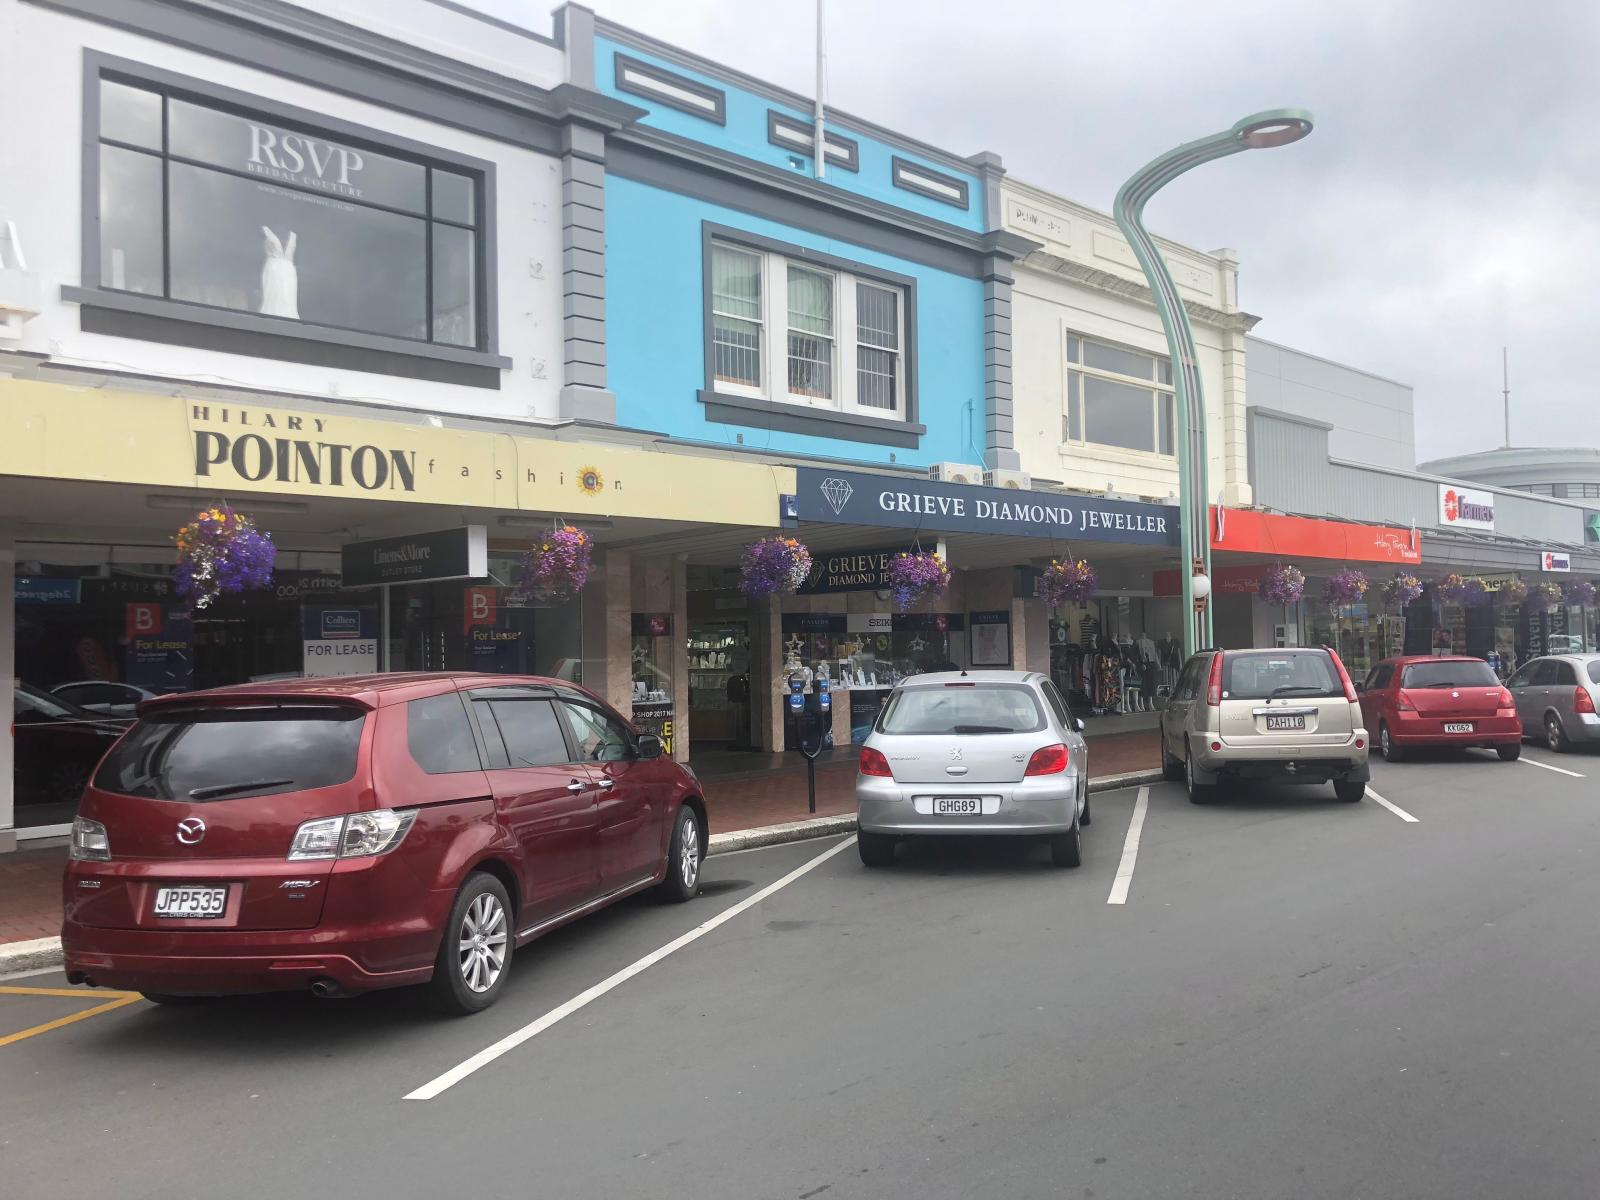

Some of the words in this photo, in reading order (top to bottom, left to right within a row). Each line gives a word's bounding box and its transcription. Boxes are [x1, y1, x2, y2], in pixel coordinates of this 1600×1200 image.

[248, 125, 363, 185] RSVP
[247, 162, 297, 181] BRIDAL
[303, 176, 362, 197] COUTURE
[192, 405, 327, 432] HILARY
[193, 430, 416, 491] POINTON
[428, 459, 623, 491] fashin
[879, 491, 965, 517] GRIEVE
[975, 500, 1073, 525] DIAMOND
[1080, 510, 1167, 533] JEWELLER
[1457, 495, 1494, 522] Farmers
[828, 554, 889, 574] GRIEVE
[829, 573, 875, 586] DIAMOND
[868, 618, 892, 627] SEIK
[473, 631, 488, 641] For
[307, 645, 332, 656] FOR
[335, 644, 375, 656] LEASE
[939, 800, 976, 812] GHG89
[157, 890, 224, 911] JPP535
